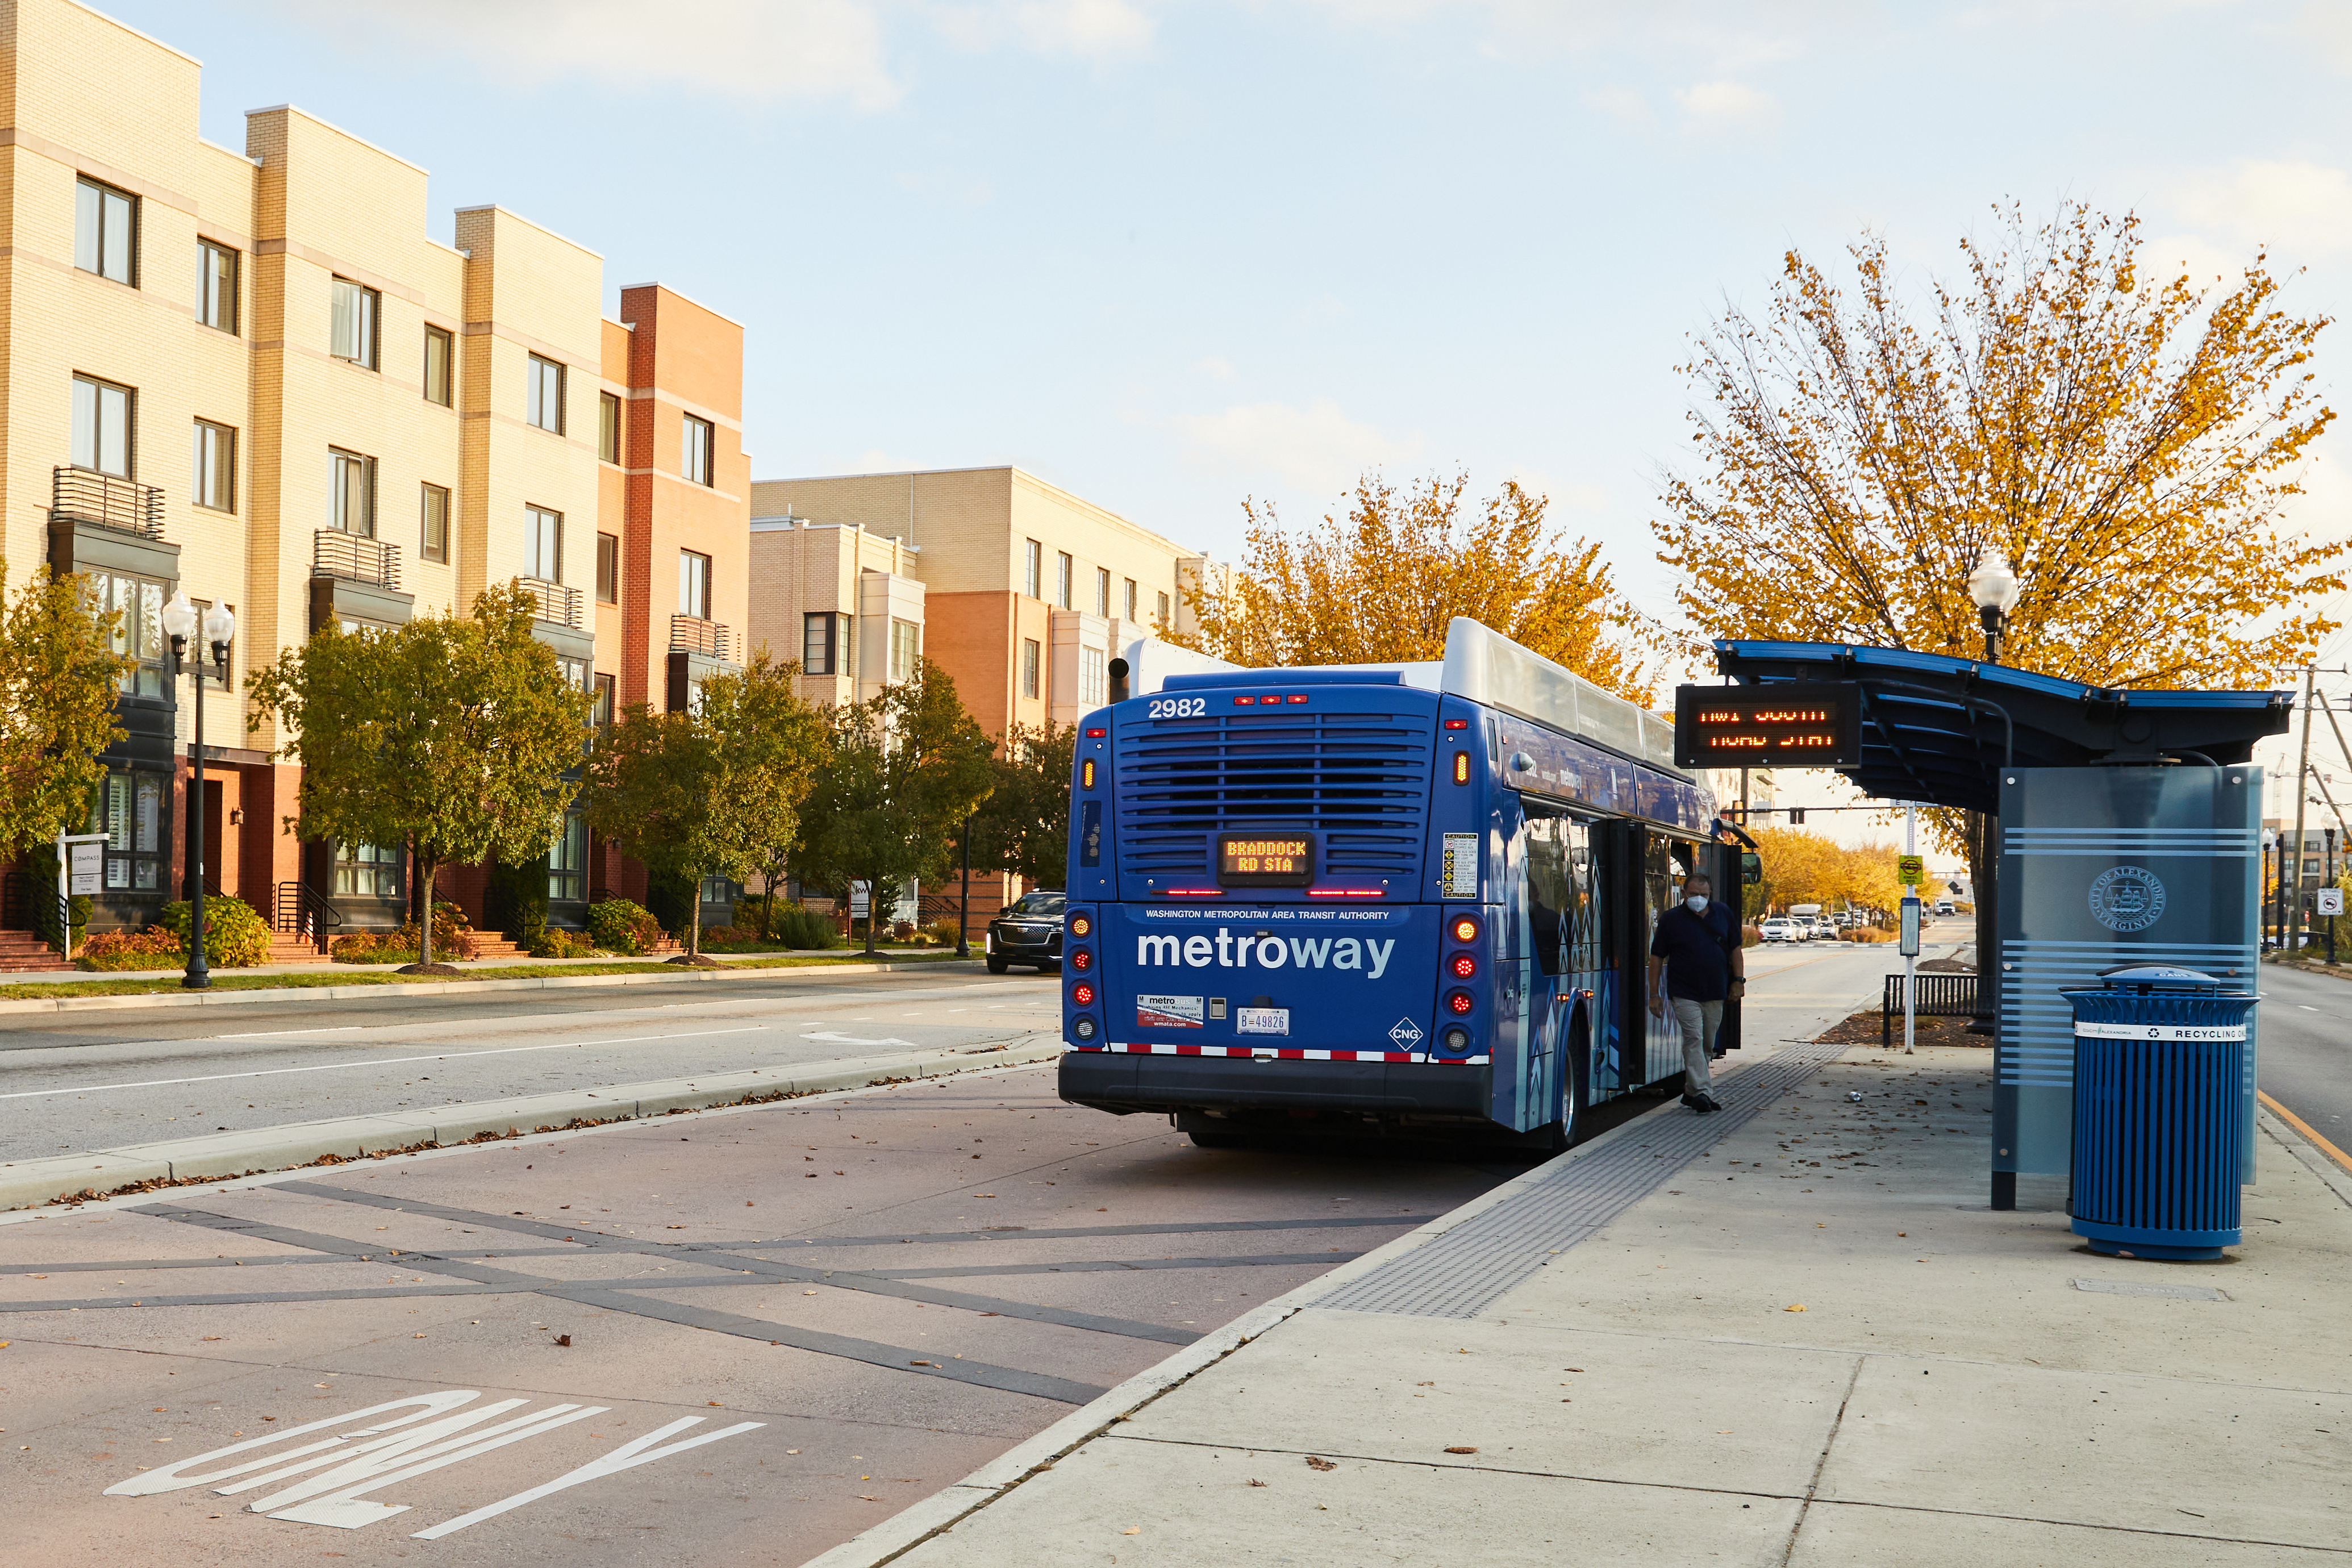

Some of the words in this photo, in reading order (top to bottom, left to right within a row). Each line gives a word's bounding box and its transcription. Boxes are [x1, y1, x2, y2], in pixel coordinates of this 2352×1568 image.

[1149, 698, 1205, 718] 2982
[1228, 842, 1306, 856] BRADDOCK
[1238, 858, 1258, 871] RD
[1265, 858, 1292, 871] STA
[2092, 886, 2101, 909] CITY
[2098, 873, 2111, 886] OF
[2113, 868, 2163, 910] ALEXANDRIA
[2099, 911, 2157, 930] VIRGINIA
[1138, 928, 1395, 979] metroway
[1242, 1015, 1247, 1027] B
[1256, 1016, 1284, 1028] 49826
[1392, 1029, 1419, 1039] CNG
[101, 1389, 768, 1540] ONLY
